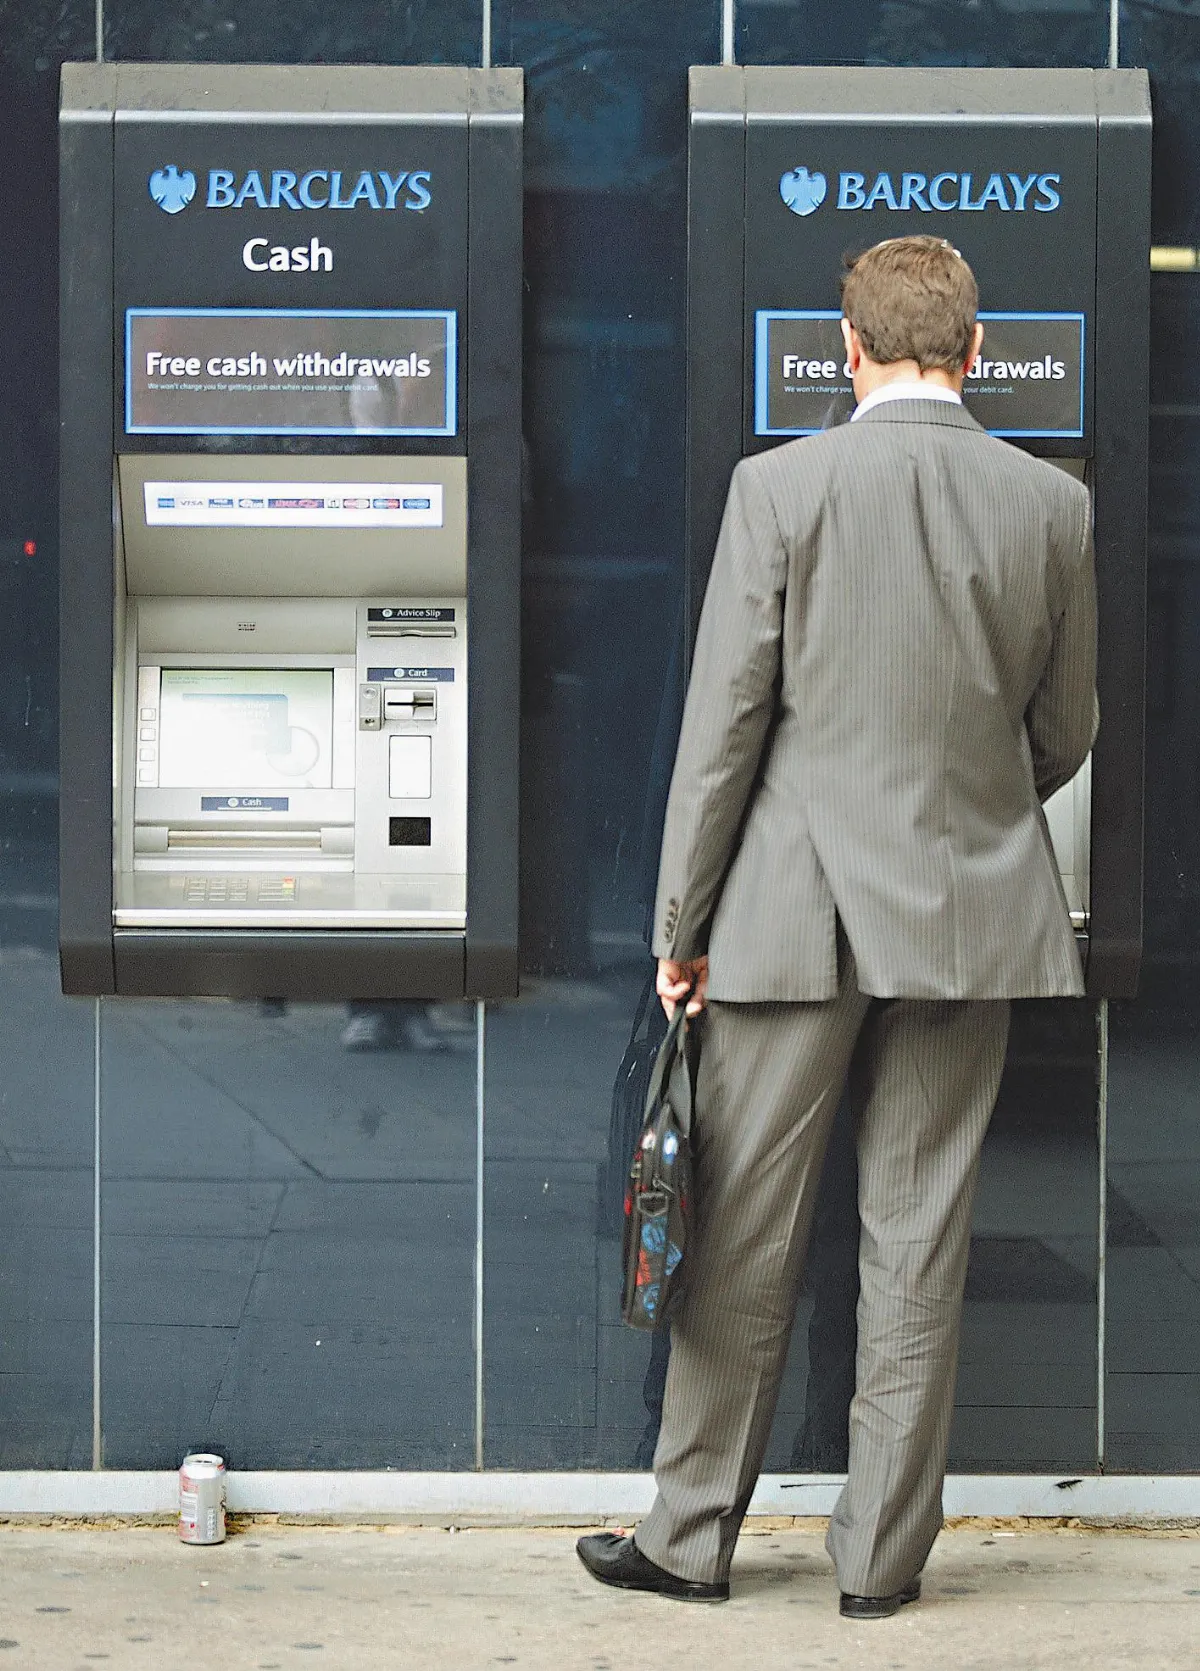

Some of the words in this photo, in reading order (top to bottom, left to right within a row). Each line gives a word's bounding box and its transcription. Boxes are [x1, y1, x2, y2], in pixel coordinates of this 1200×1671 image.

[206, 170, 432, 210] BARCLAYS
[837, 172, 1061, 212] BARCLAYS
[242, 237, 334, 272] Cash
[146, 352, 201, 376] Free
[206, 352, 267, 376] cash
[273, 352, 431, 377] withdrawals
[783, 355, 837, 379] Free
[966, 354, 1066, 379] drawals
[180, 383, 202, 392] charge
[203, 384, 217, 392] you
[228, 384, 252, 392] getting
[816, 386, 838, 394] charge
[397, 609, 424, 617] Advice
[425, 609, 441, 618] Slip
[408, 668, 428, 677] Card
[242, 798, 262, 806] Cash
